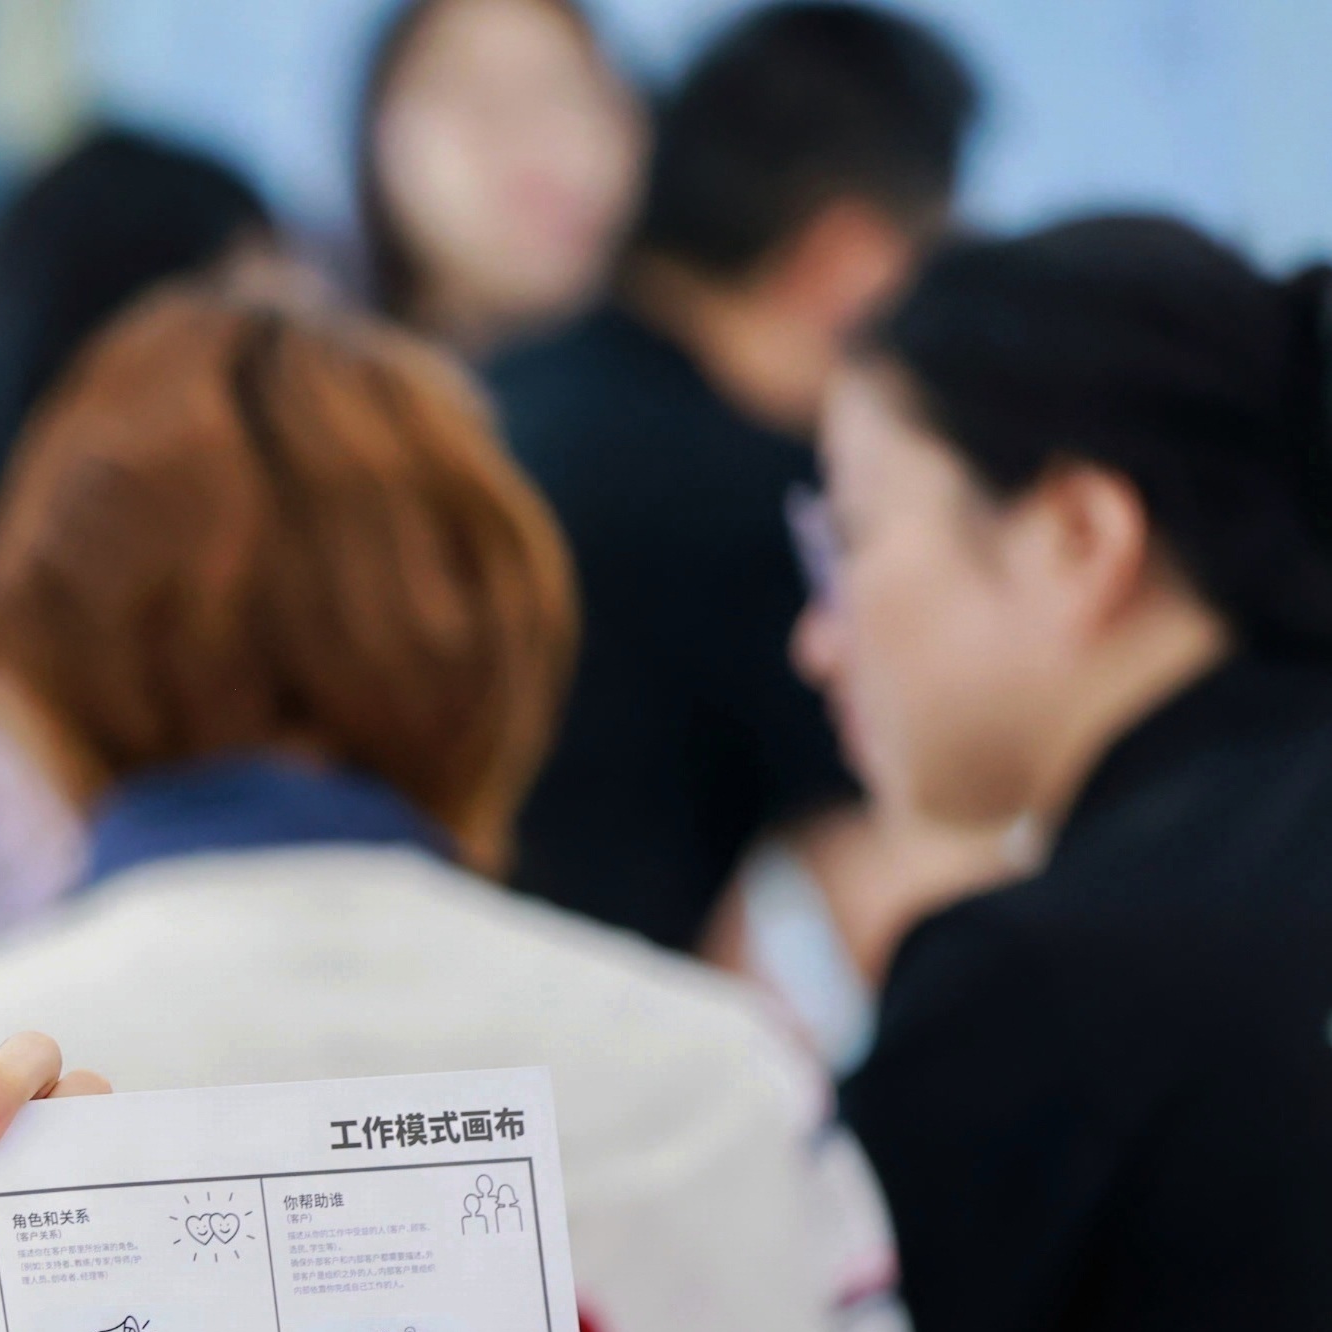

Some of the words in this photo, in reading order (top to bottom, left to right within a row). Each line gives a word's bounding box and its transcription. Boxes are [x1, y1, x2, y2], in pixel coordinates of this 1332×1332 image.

[330, 1107, 524, 1150] 工作模式画布
[283, 1191, 345, 1212] 你帮助谁
[12, 1207, 90, 1230] 角色和关系
[286, 1213, 313, 1225] （客户）
[15, 1229, 62, 1242] （客户关系）
